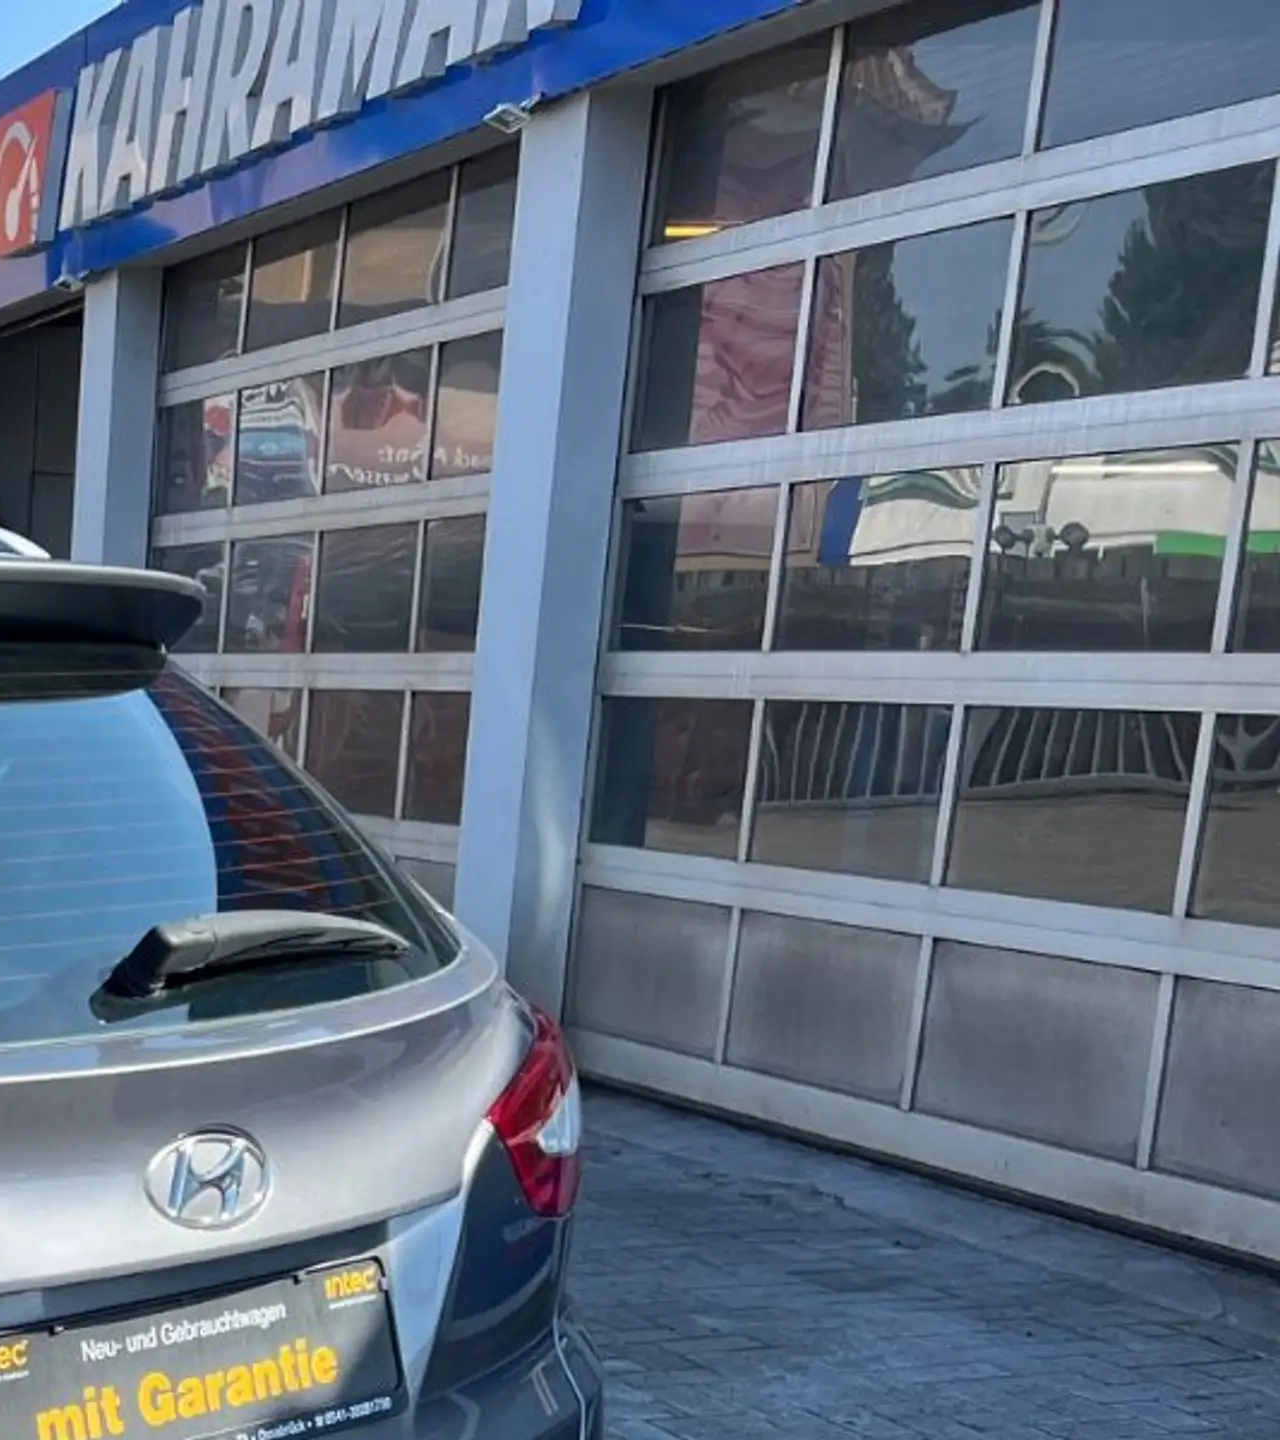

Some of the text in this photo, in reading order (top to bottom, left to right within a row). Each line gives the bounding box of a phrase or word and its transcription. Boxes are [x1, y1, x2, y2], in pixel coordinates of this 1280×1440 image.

[59, 0, 582, 232] KAHRAMA
[324, 1267, 376, 1300] intec
[80, 1302, 286, 1362] Neu- und Gebrauchtwagen
[138, 1337, 340, 1426] Garantie
